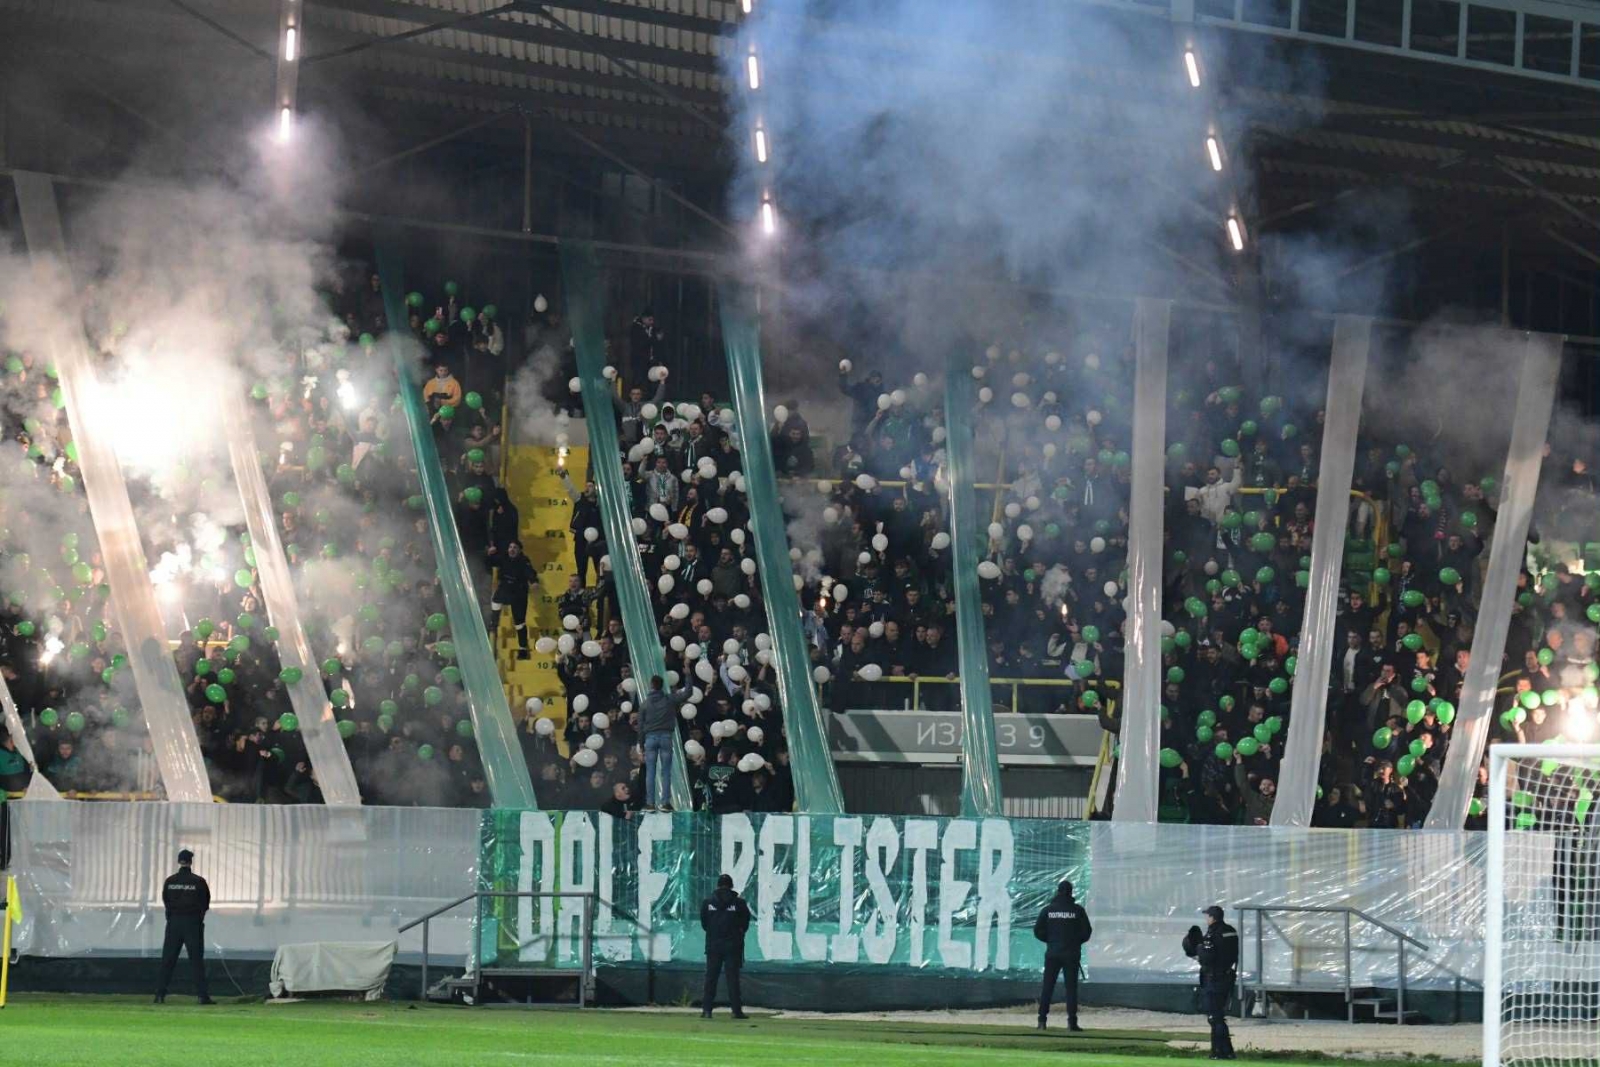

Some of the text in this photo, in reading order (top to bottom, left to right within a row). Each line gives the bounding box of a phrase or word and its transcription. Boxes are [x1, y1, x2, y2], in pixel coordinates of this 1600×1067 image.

[543, 563, 553, 571] 13
[917, 722, 1045, 748] ИЗЗ 9
[517, 810, 1015, 971] DALE PELISTER
